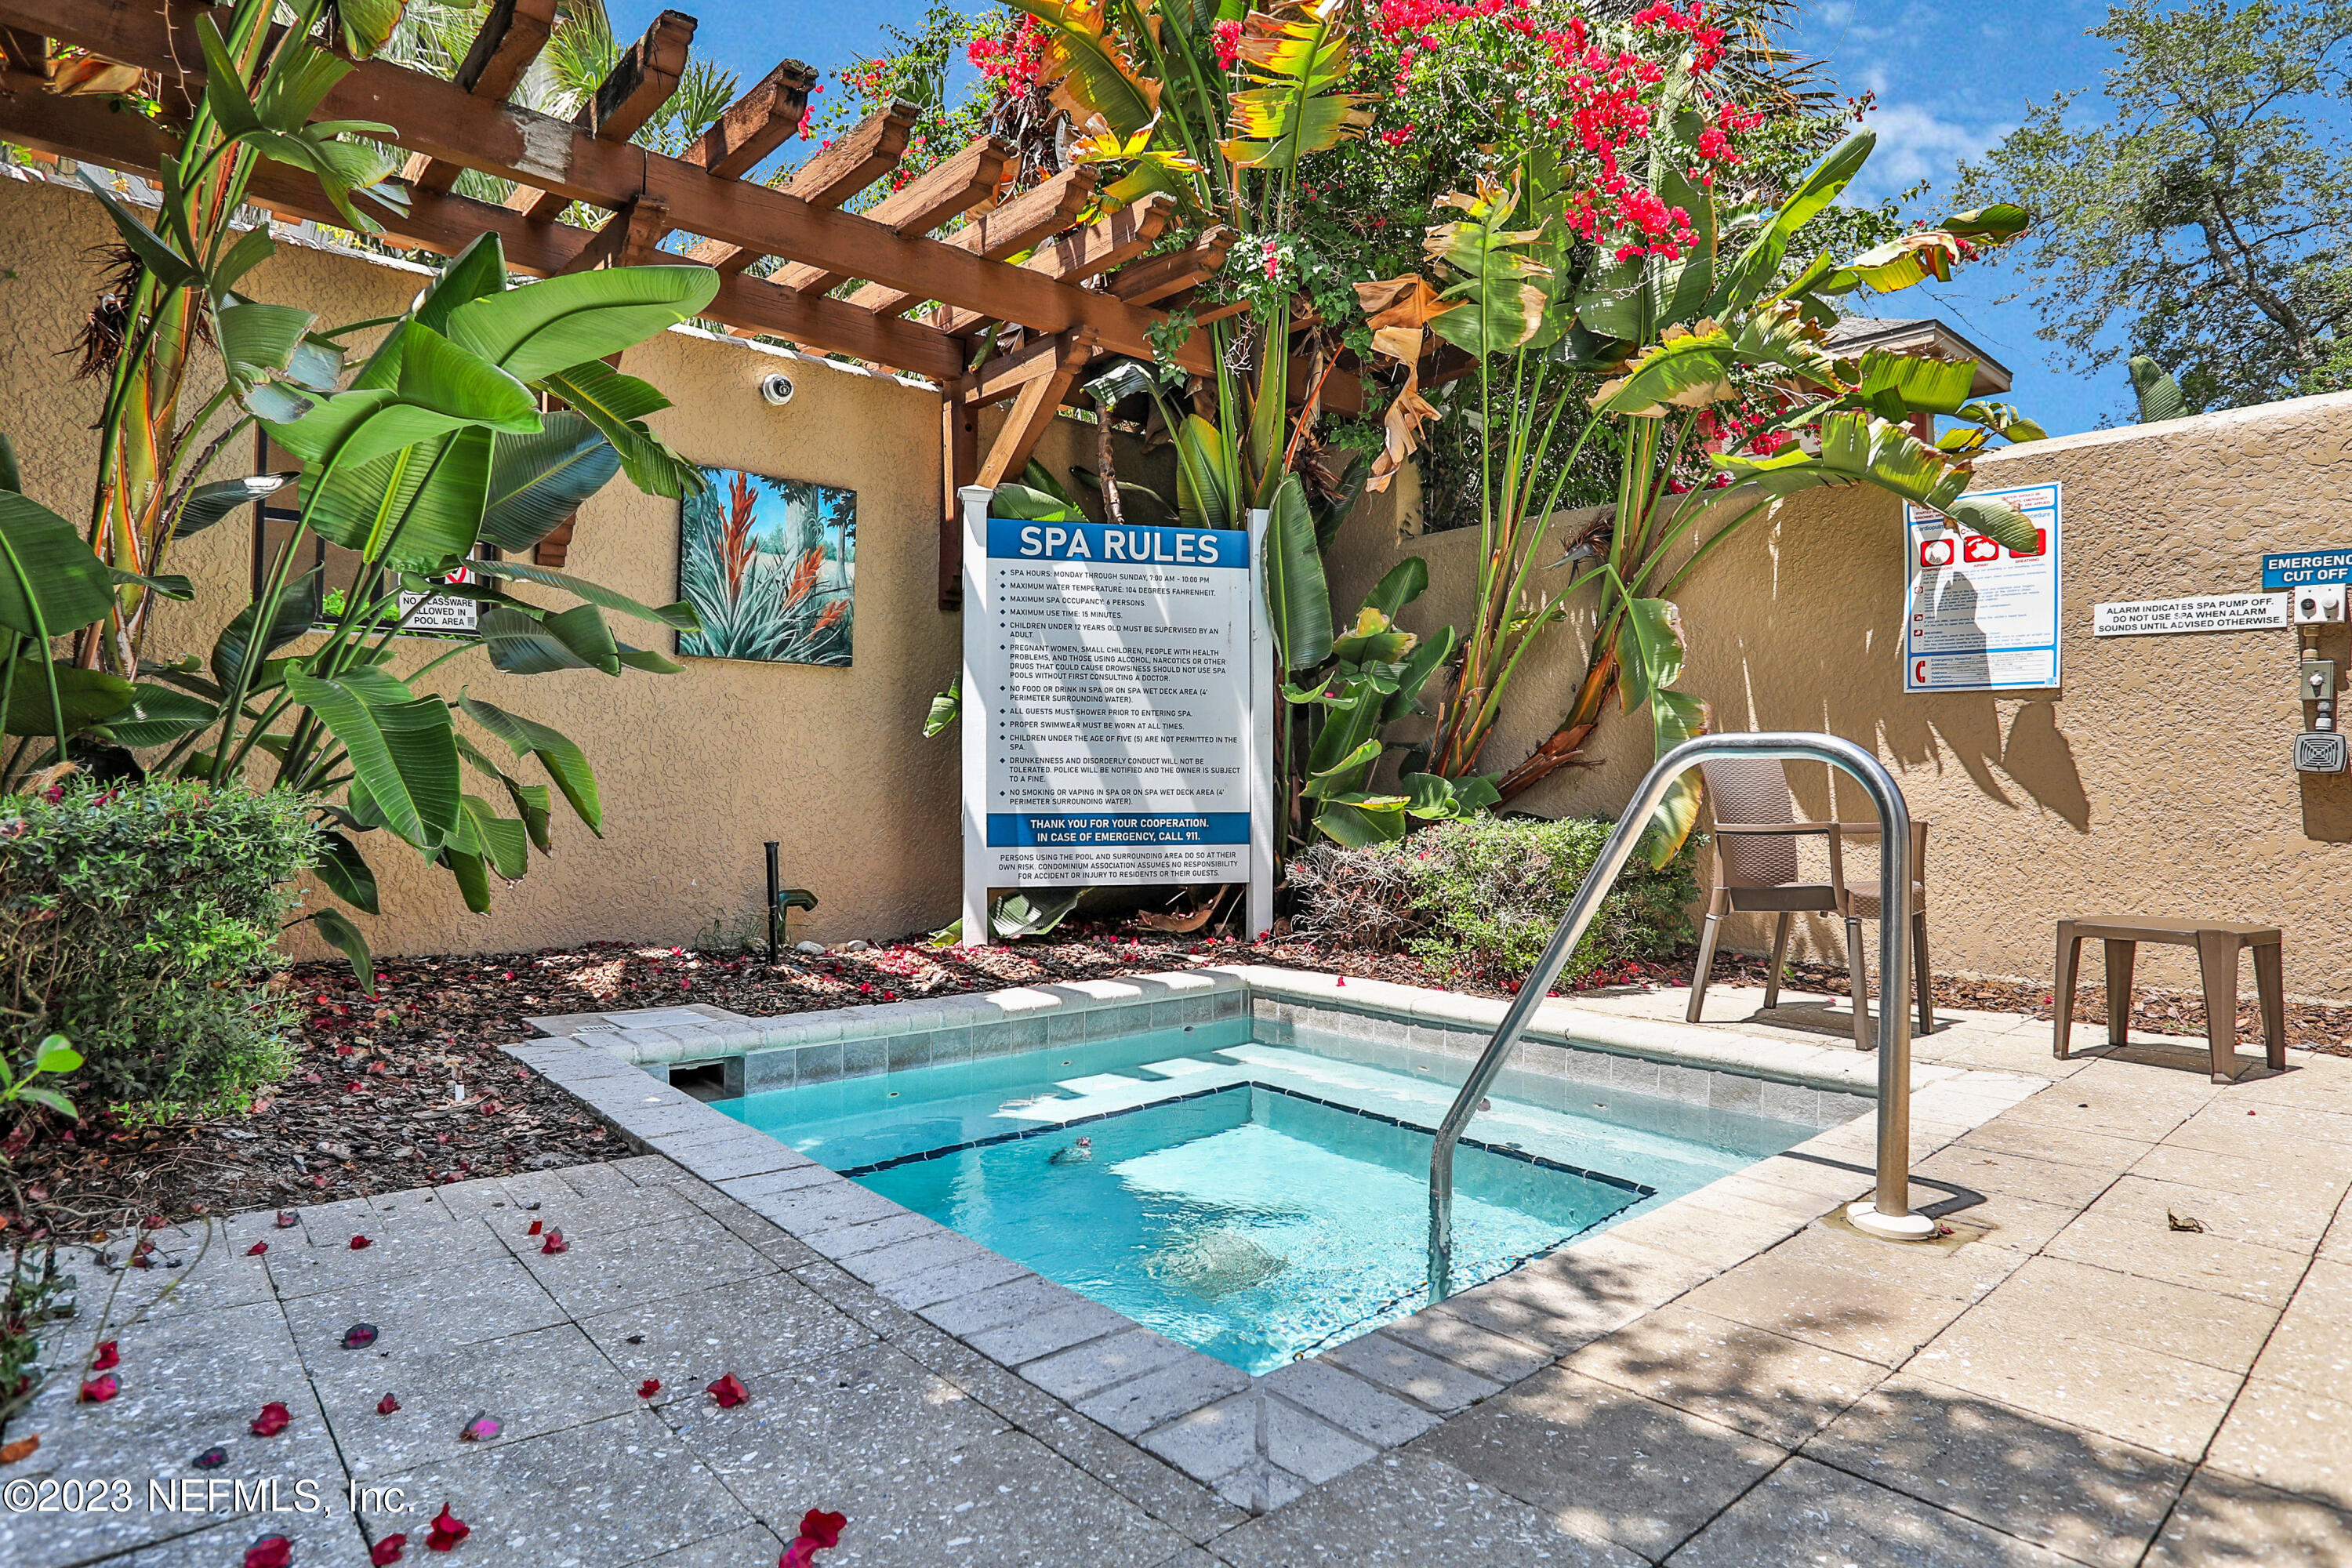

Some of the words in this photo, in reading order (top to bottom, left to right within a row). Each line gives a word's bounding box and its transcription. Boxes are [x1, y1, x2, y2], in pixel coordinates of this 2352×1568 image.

[1019, 525, 1091, 559] SPA
[1104, 529, 1219, 564] RULES
[2283, 570, 2314, 582] CUT
[2318, 568, 2349, 580] OFF
[426, 597, 473, 607] LASSWARE
[2107, 605, 2140, 615] ALARM
[2142, 602, 2194, 612] INDICATES
[2196, 601, 2216, 610] SPA
[2219, 599, 2249, 608] PUMP
[2250, 597, 2274, 607] OFF.
[414, 616, 438, 625] POOL
[2112, 615, 2127, 623] DO
[2129, 614, 2149, 622] NOT
[2151, 612, 2171, 621] USE
[2194, 610, 2226, 619] WHEN
[2228, 608, 2267, 617] ALARM
[1009, 622, 1046, 630] CHILDREN
[2098, 623, 2138, 633] SOUNDS
[2140, 622, 2169, 630] UNTIL
[2169, 619, 2215, 630] ADVISED
[2216, 616, 2283, 627] OTHERWISE.
[1029, 819, 1065, 829] THANK
[1065, 819, 1087, 829] YOU
[1089, 819, 1109, 828] FOR
[1109, 818, 1138, 828] YOUR
[1140, 818, 1209, 828] COOPERATION.
[1036, 833, 1047, 842] IN
[1050, 833, 1076, 842] CASE
[1079, 833, 1093, 842] OF
[1094, 832, 1156, 843] EMERGENCY,
[1158, 832, 1184, 840] CALL
[1184, 831, 1203, 840] 911.
